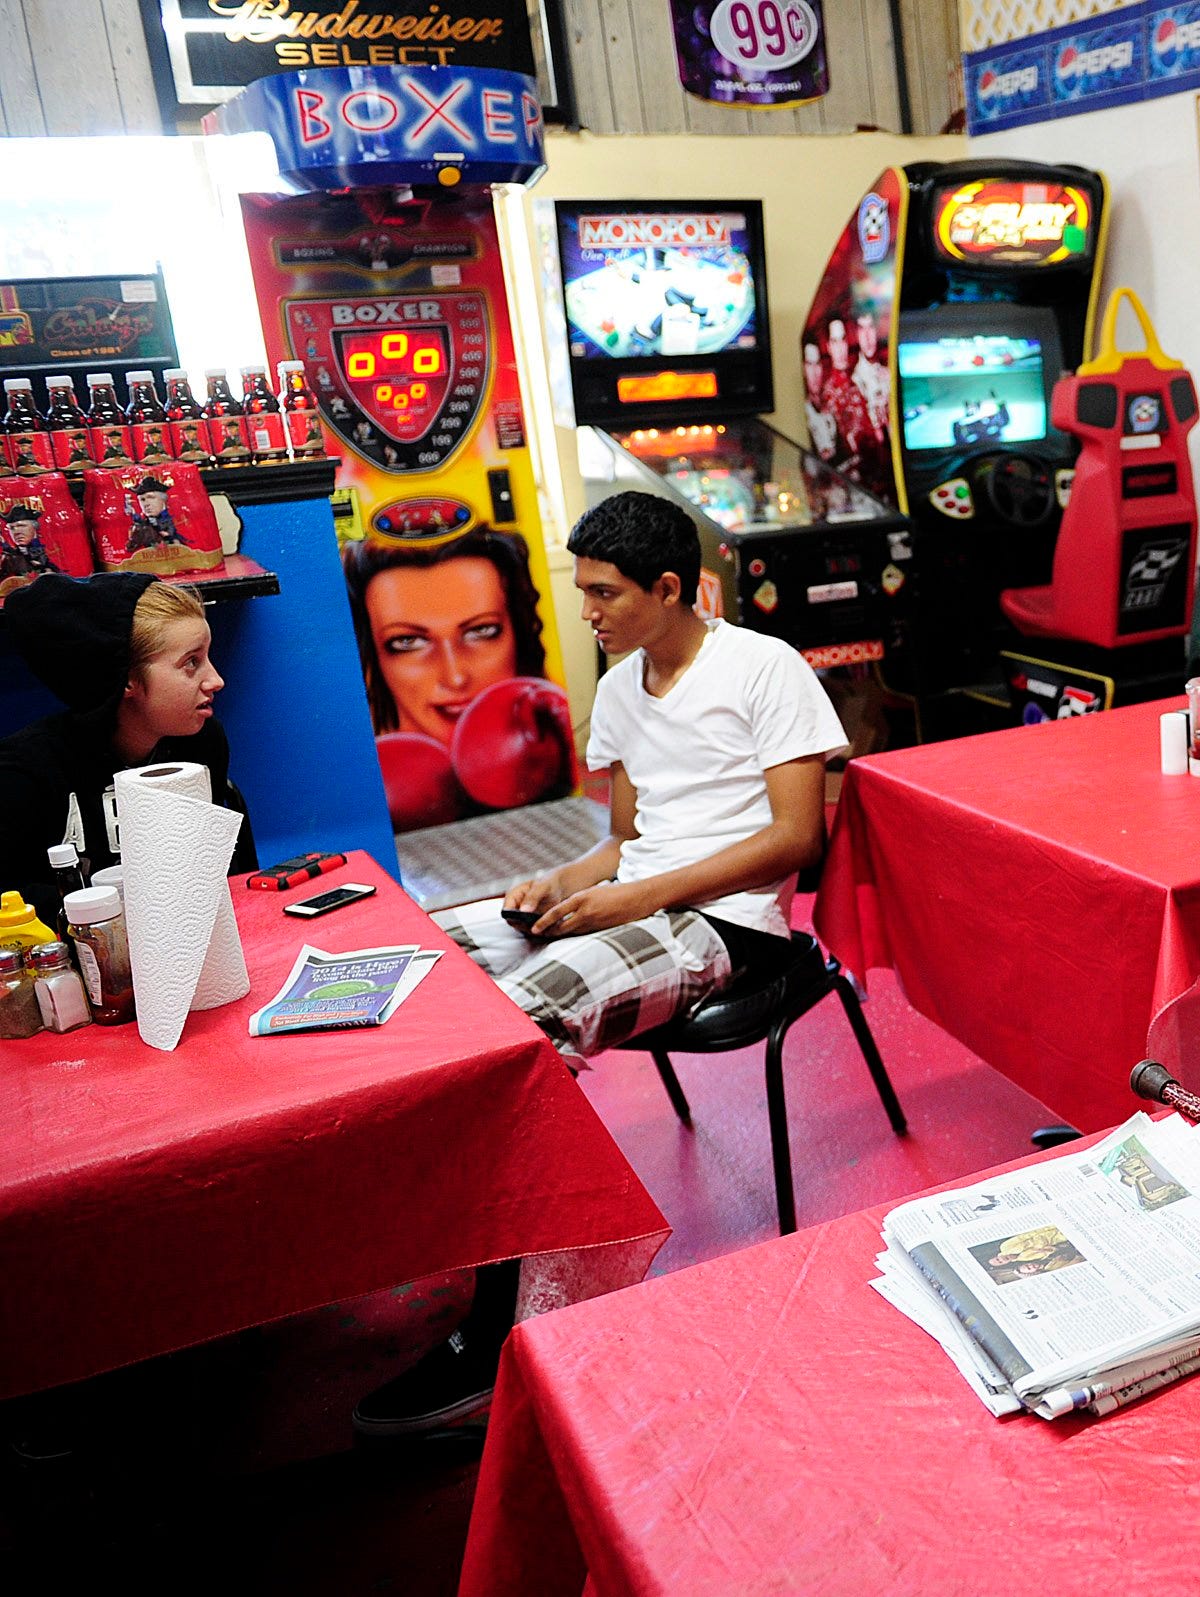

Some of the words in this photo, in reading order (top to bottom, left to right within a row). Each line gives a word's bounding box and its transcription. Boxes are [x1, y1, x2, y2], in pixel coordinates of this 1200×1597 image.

[208, 0, 503, 43] Budweiser
[275, 43, 456, 66] SELECT
[1075, 41, 1134, 74] PEPSI
[995, 65, 1039, 97] PEPSI
[296, 81, 545, 145] BOXER
[583, 219, 727, 244] MONOPOLY
[332, 301, 443, 324] BOXER
[462, 335, 483, 345] 700
[462, 351, 483, 362] 600
[459, 368, 481, 379] 500
[454, 385, 476, 396] 400
[441, 418, 463, 430] 200
[431, 435, 453, 447] 100
[803, 642, 883, 669] ONOPOLY
[312, 965, 347, 975] 2014
[365, 959, 404, 968] Here!
